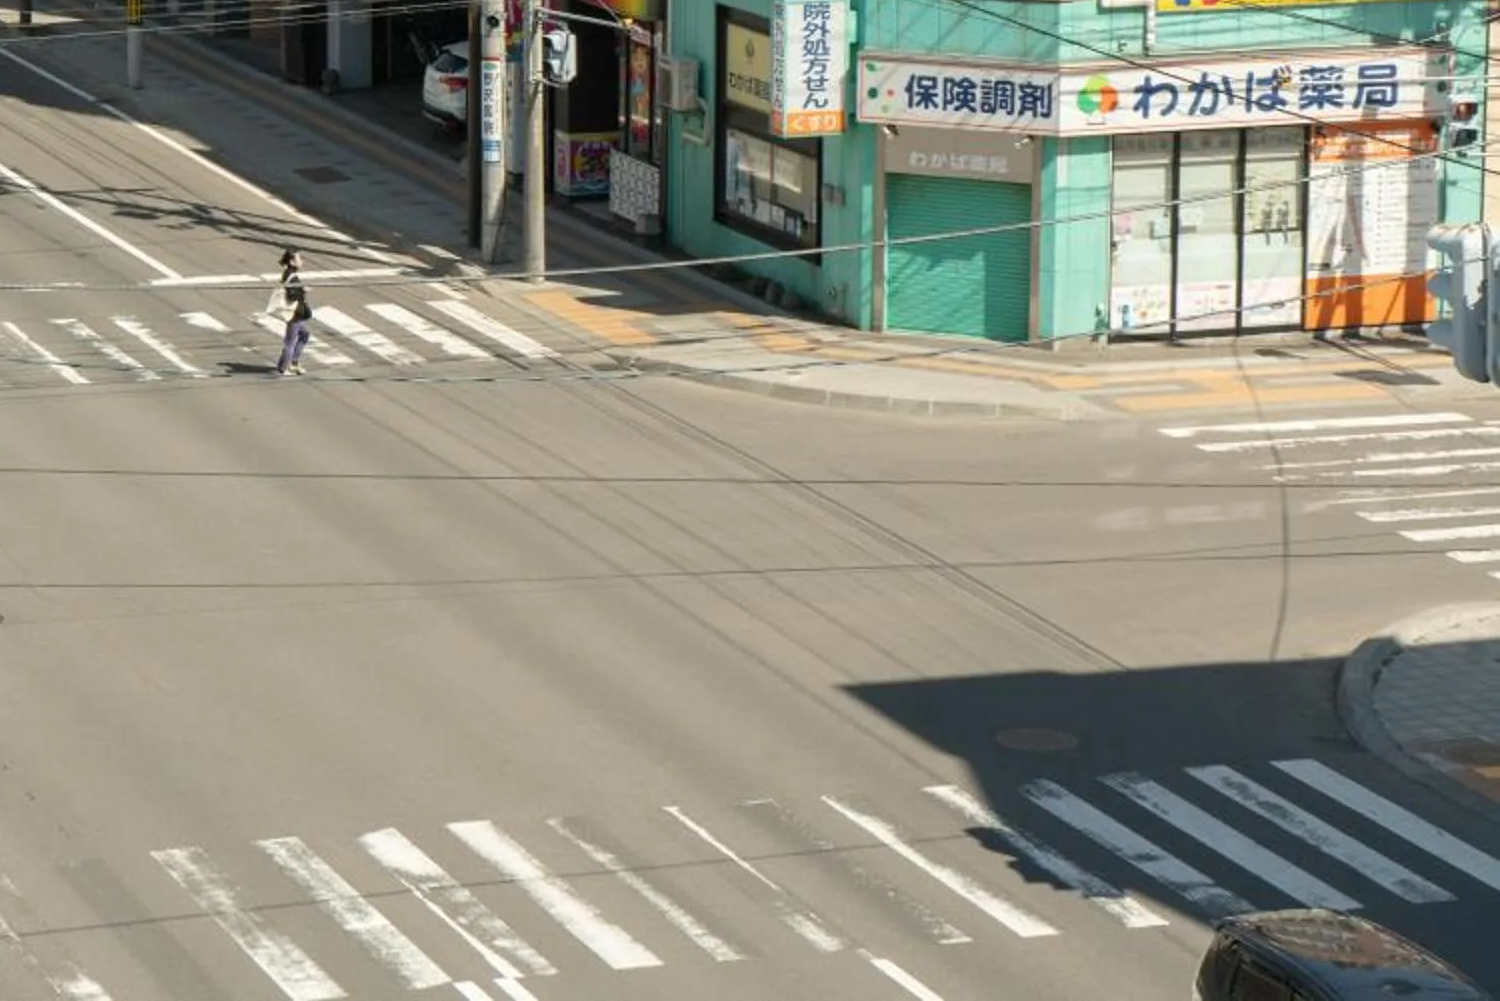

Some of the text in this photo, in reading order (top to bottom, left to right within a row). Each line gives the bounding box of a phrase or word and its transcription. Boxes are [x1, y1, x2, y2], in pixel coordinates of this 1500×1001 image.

[803, 1, 832, 109] 院外処方せん
[904, 73, 1053, 119] 保険調剤
[1132, 63, 1399, 118] わかば薬局
